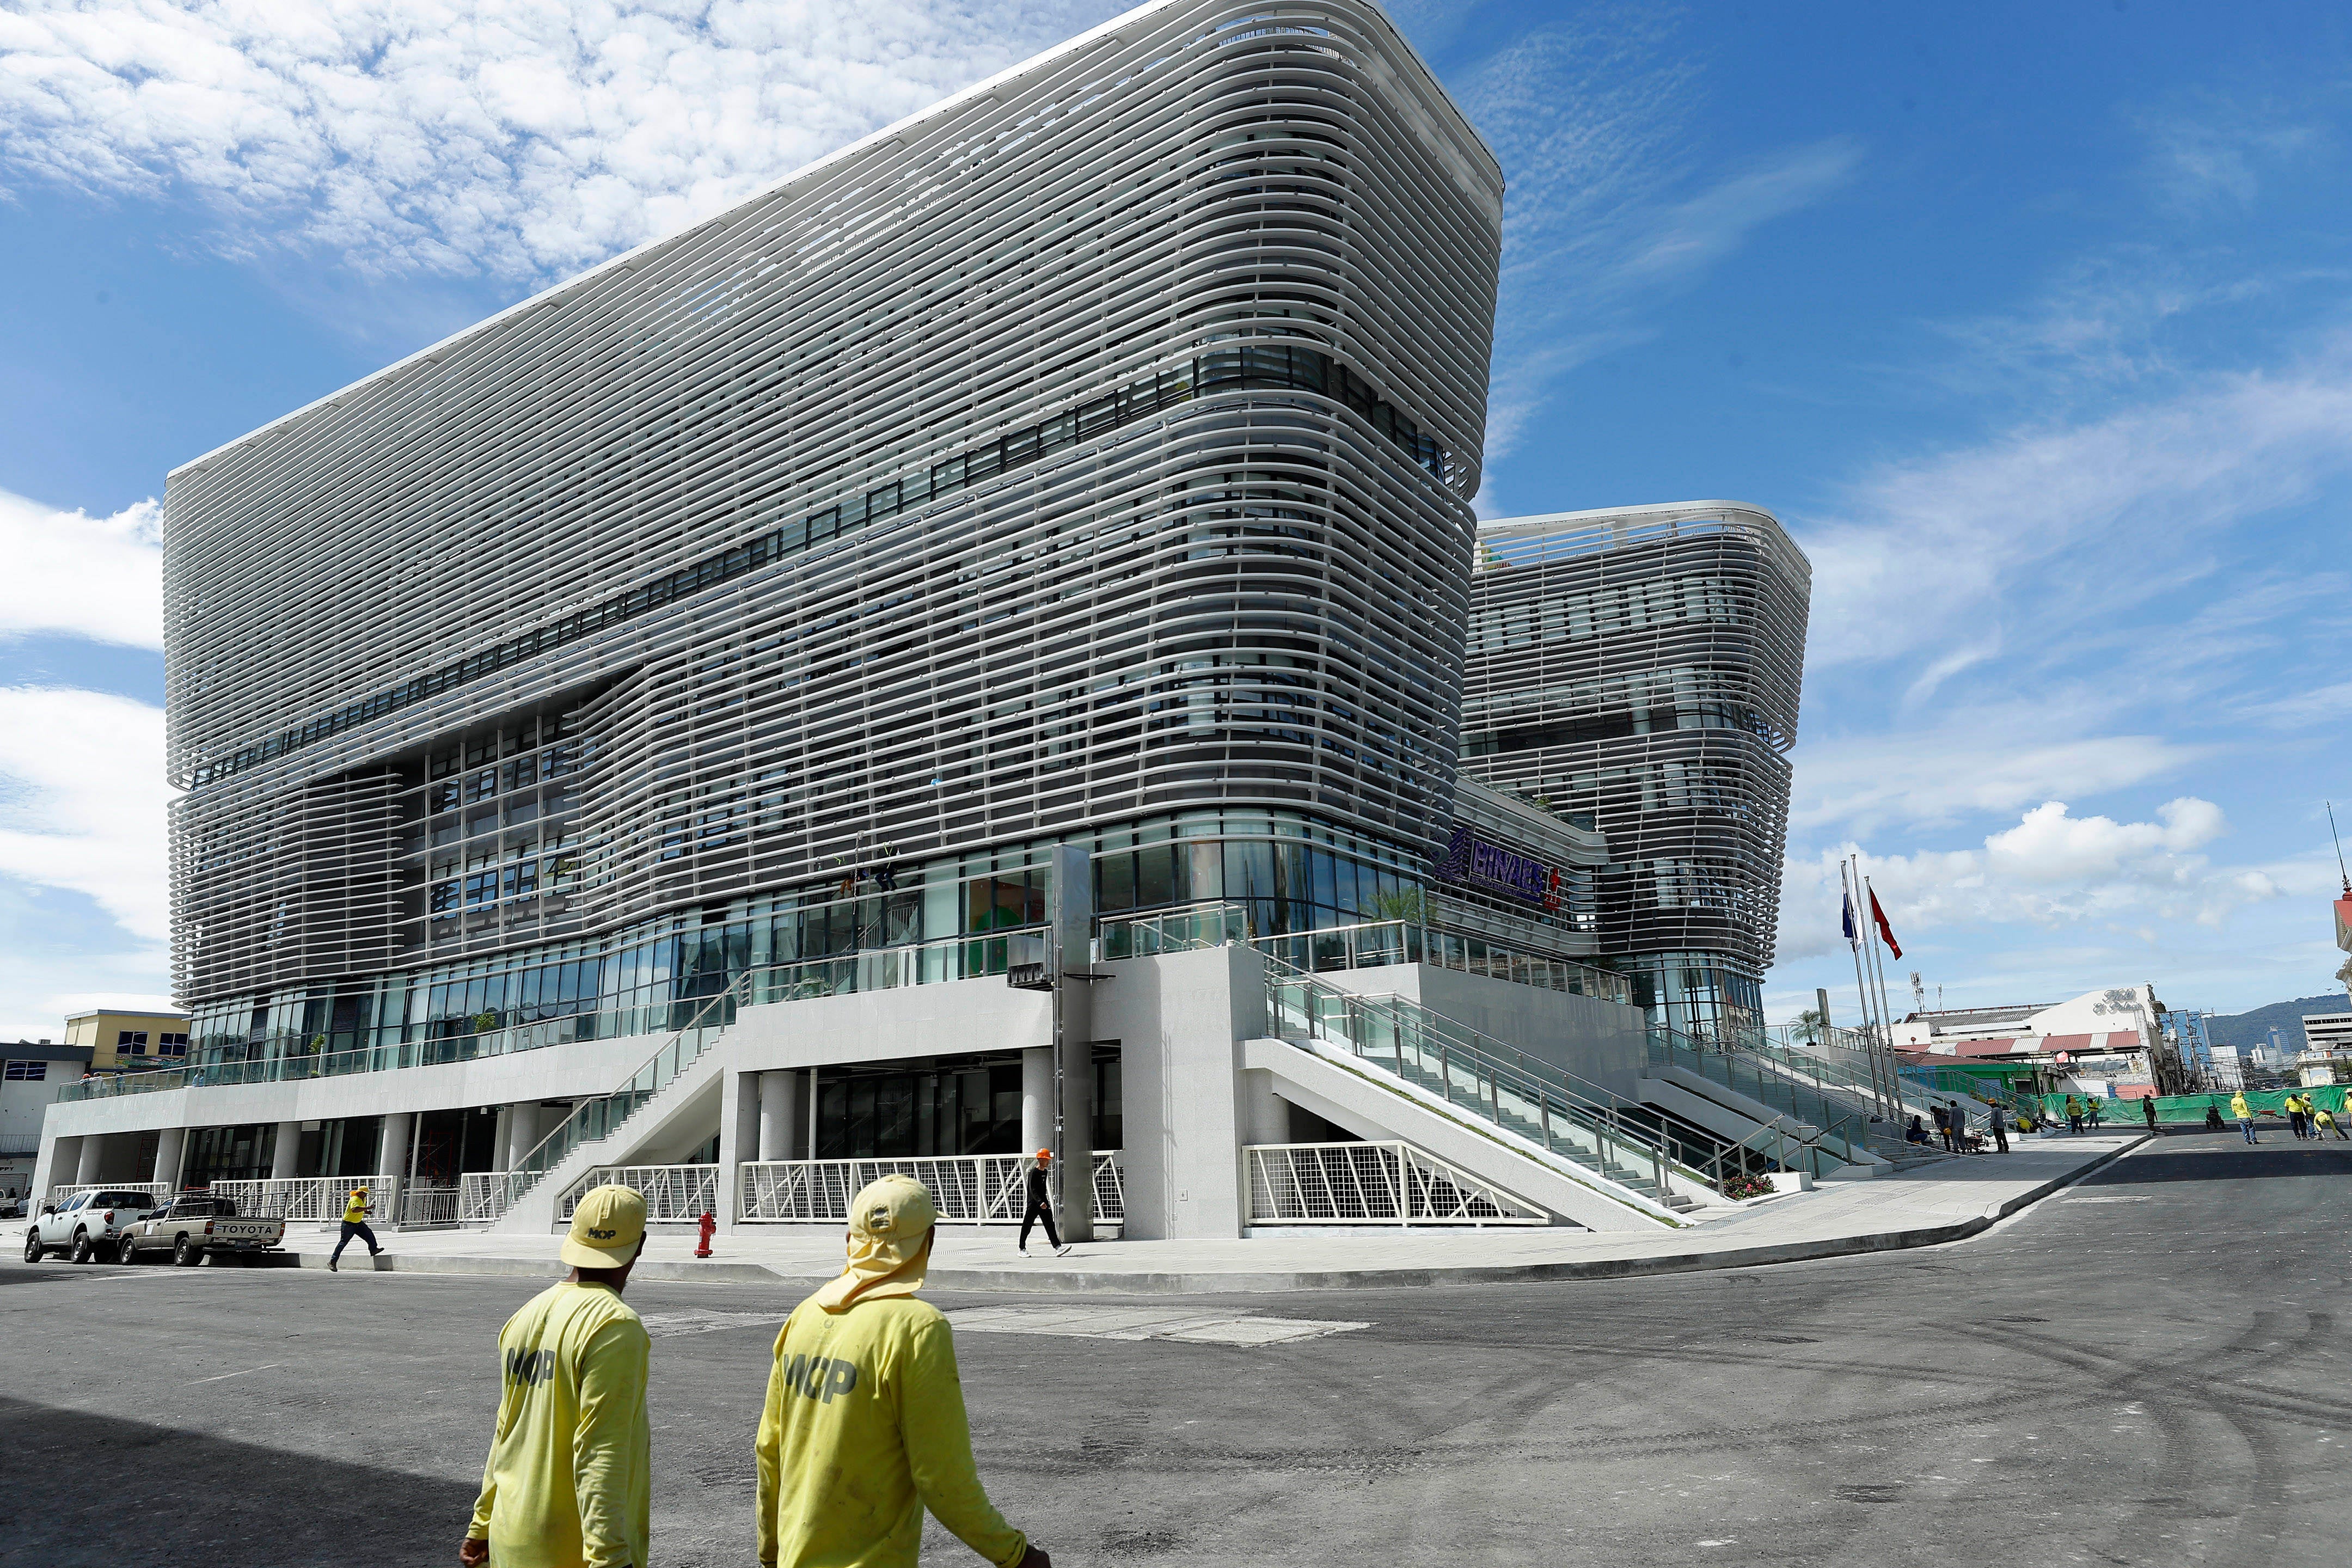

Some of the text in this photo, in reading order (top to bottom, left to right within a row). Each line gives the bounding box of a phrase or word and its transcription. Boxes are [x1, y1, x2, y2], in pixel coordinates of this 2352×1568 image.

[1473, 841, 1543, 893] BINAES
[222, 1225, 272, 1234] TOYOTA
[588, 1227, 616, 1240] MOP
[783, 1353, 857, 1404] MOP
